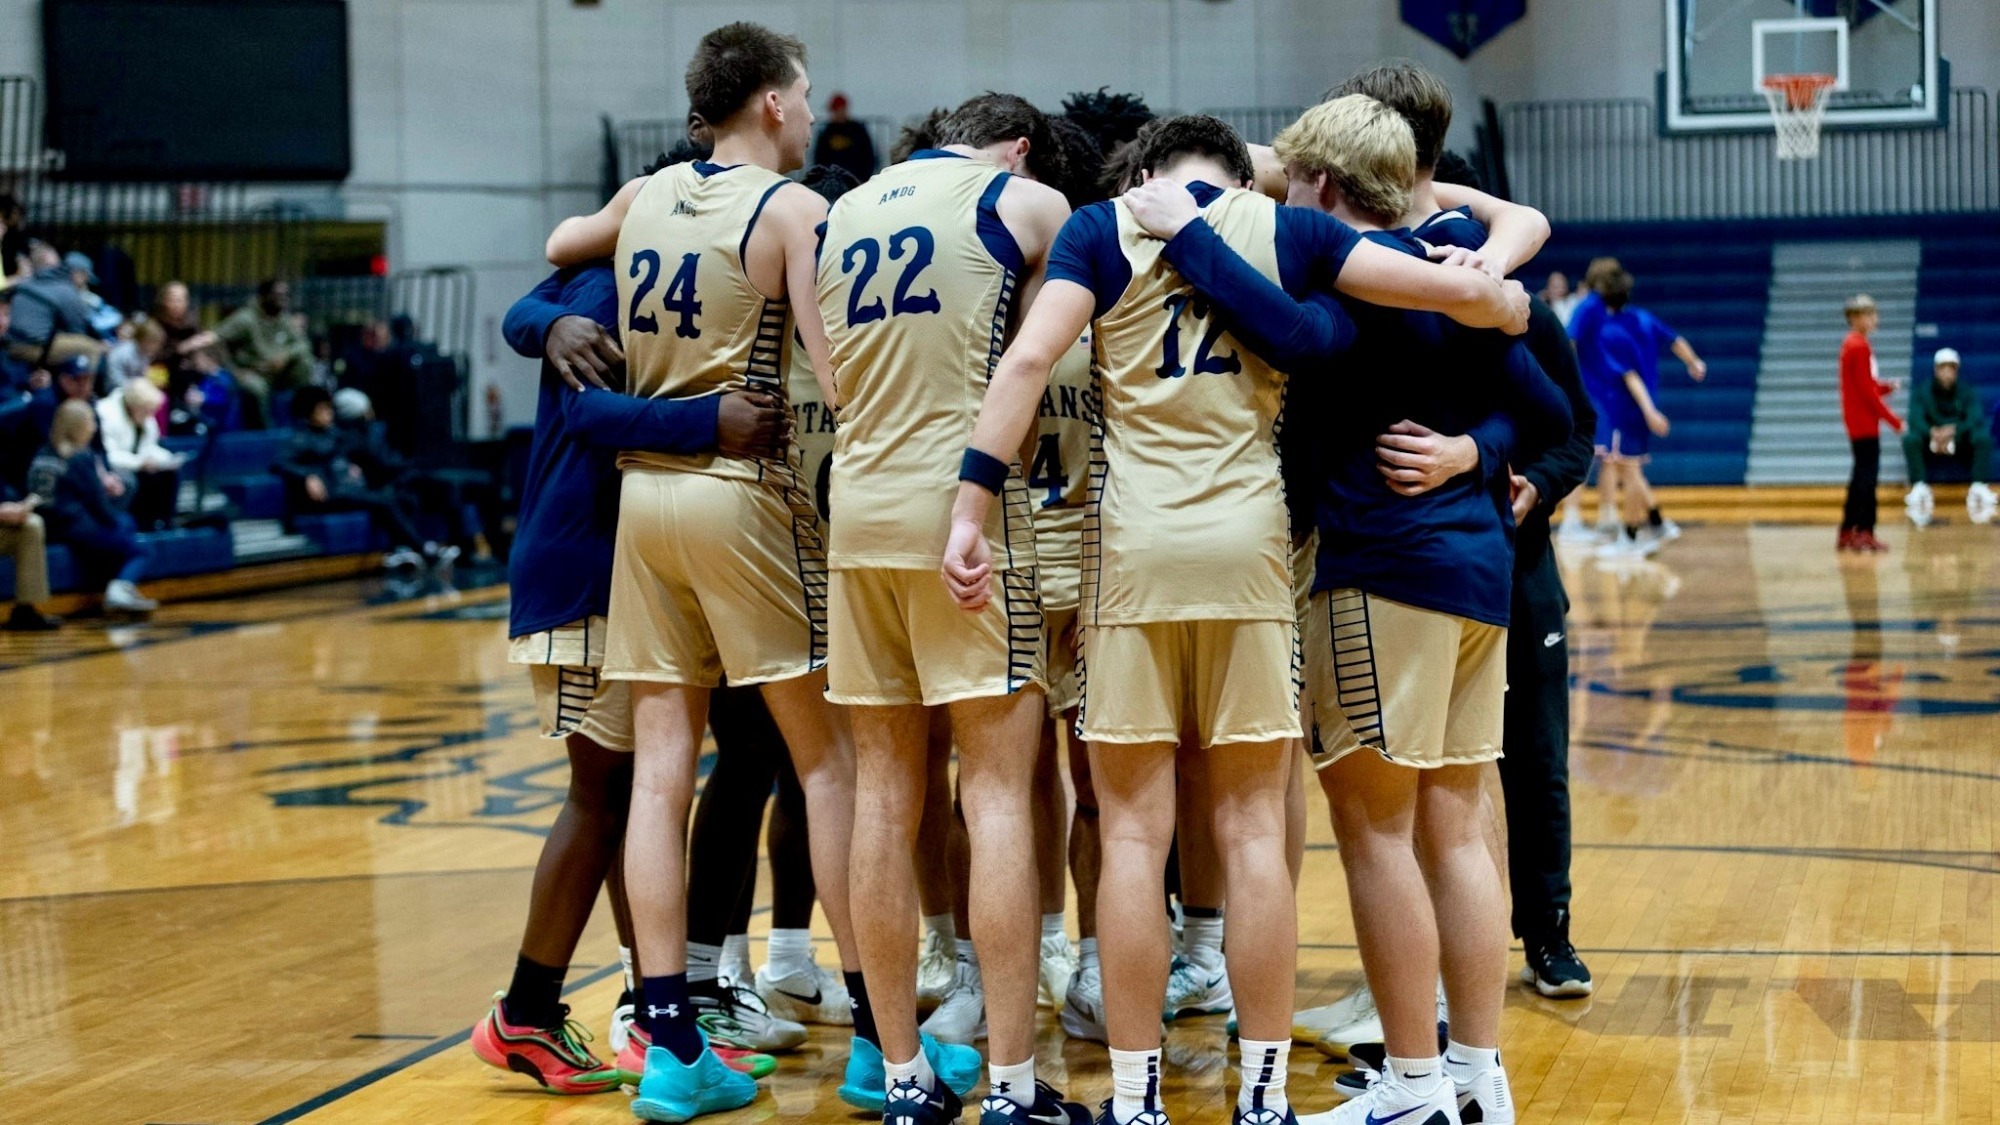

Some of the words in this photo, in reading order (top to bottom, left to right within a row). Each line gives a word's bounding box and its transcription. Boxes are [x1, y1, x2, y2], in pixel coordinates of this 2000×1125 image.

[878, 185, 916, 205] AMDG
[629, 249, 702, 339] 24
[842, 226, 941, 329] 22
[1155, 293, 1242, 379] 12
[1028, 433, 1069, 508] 4
